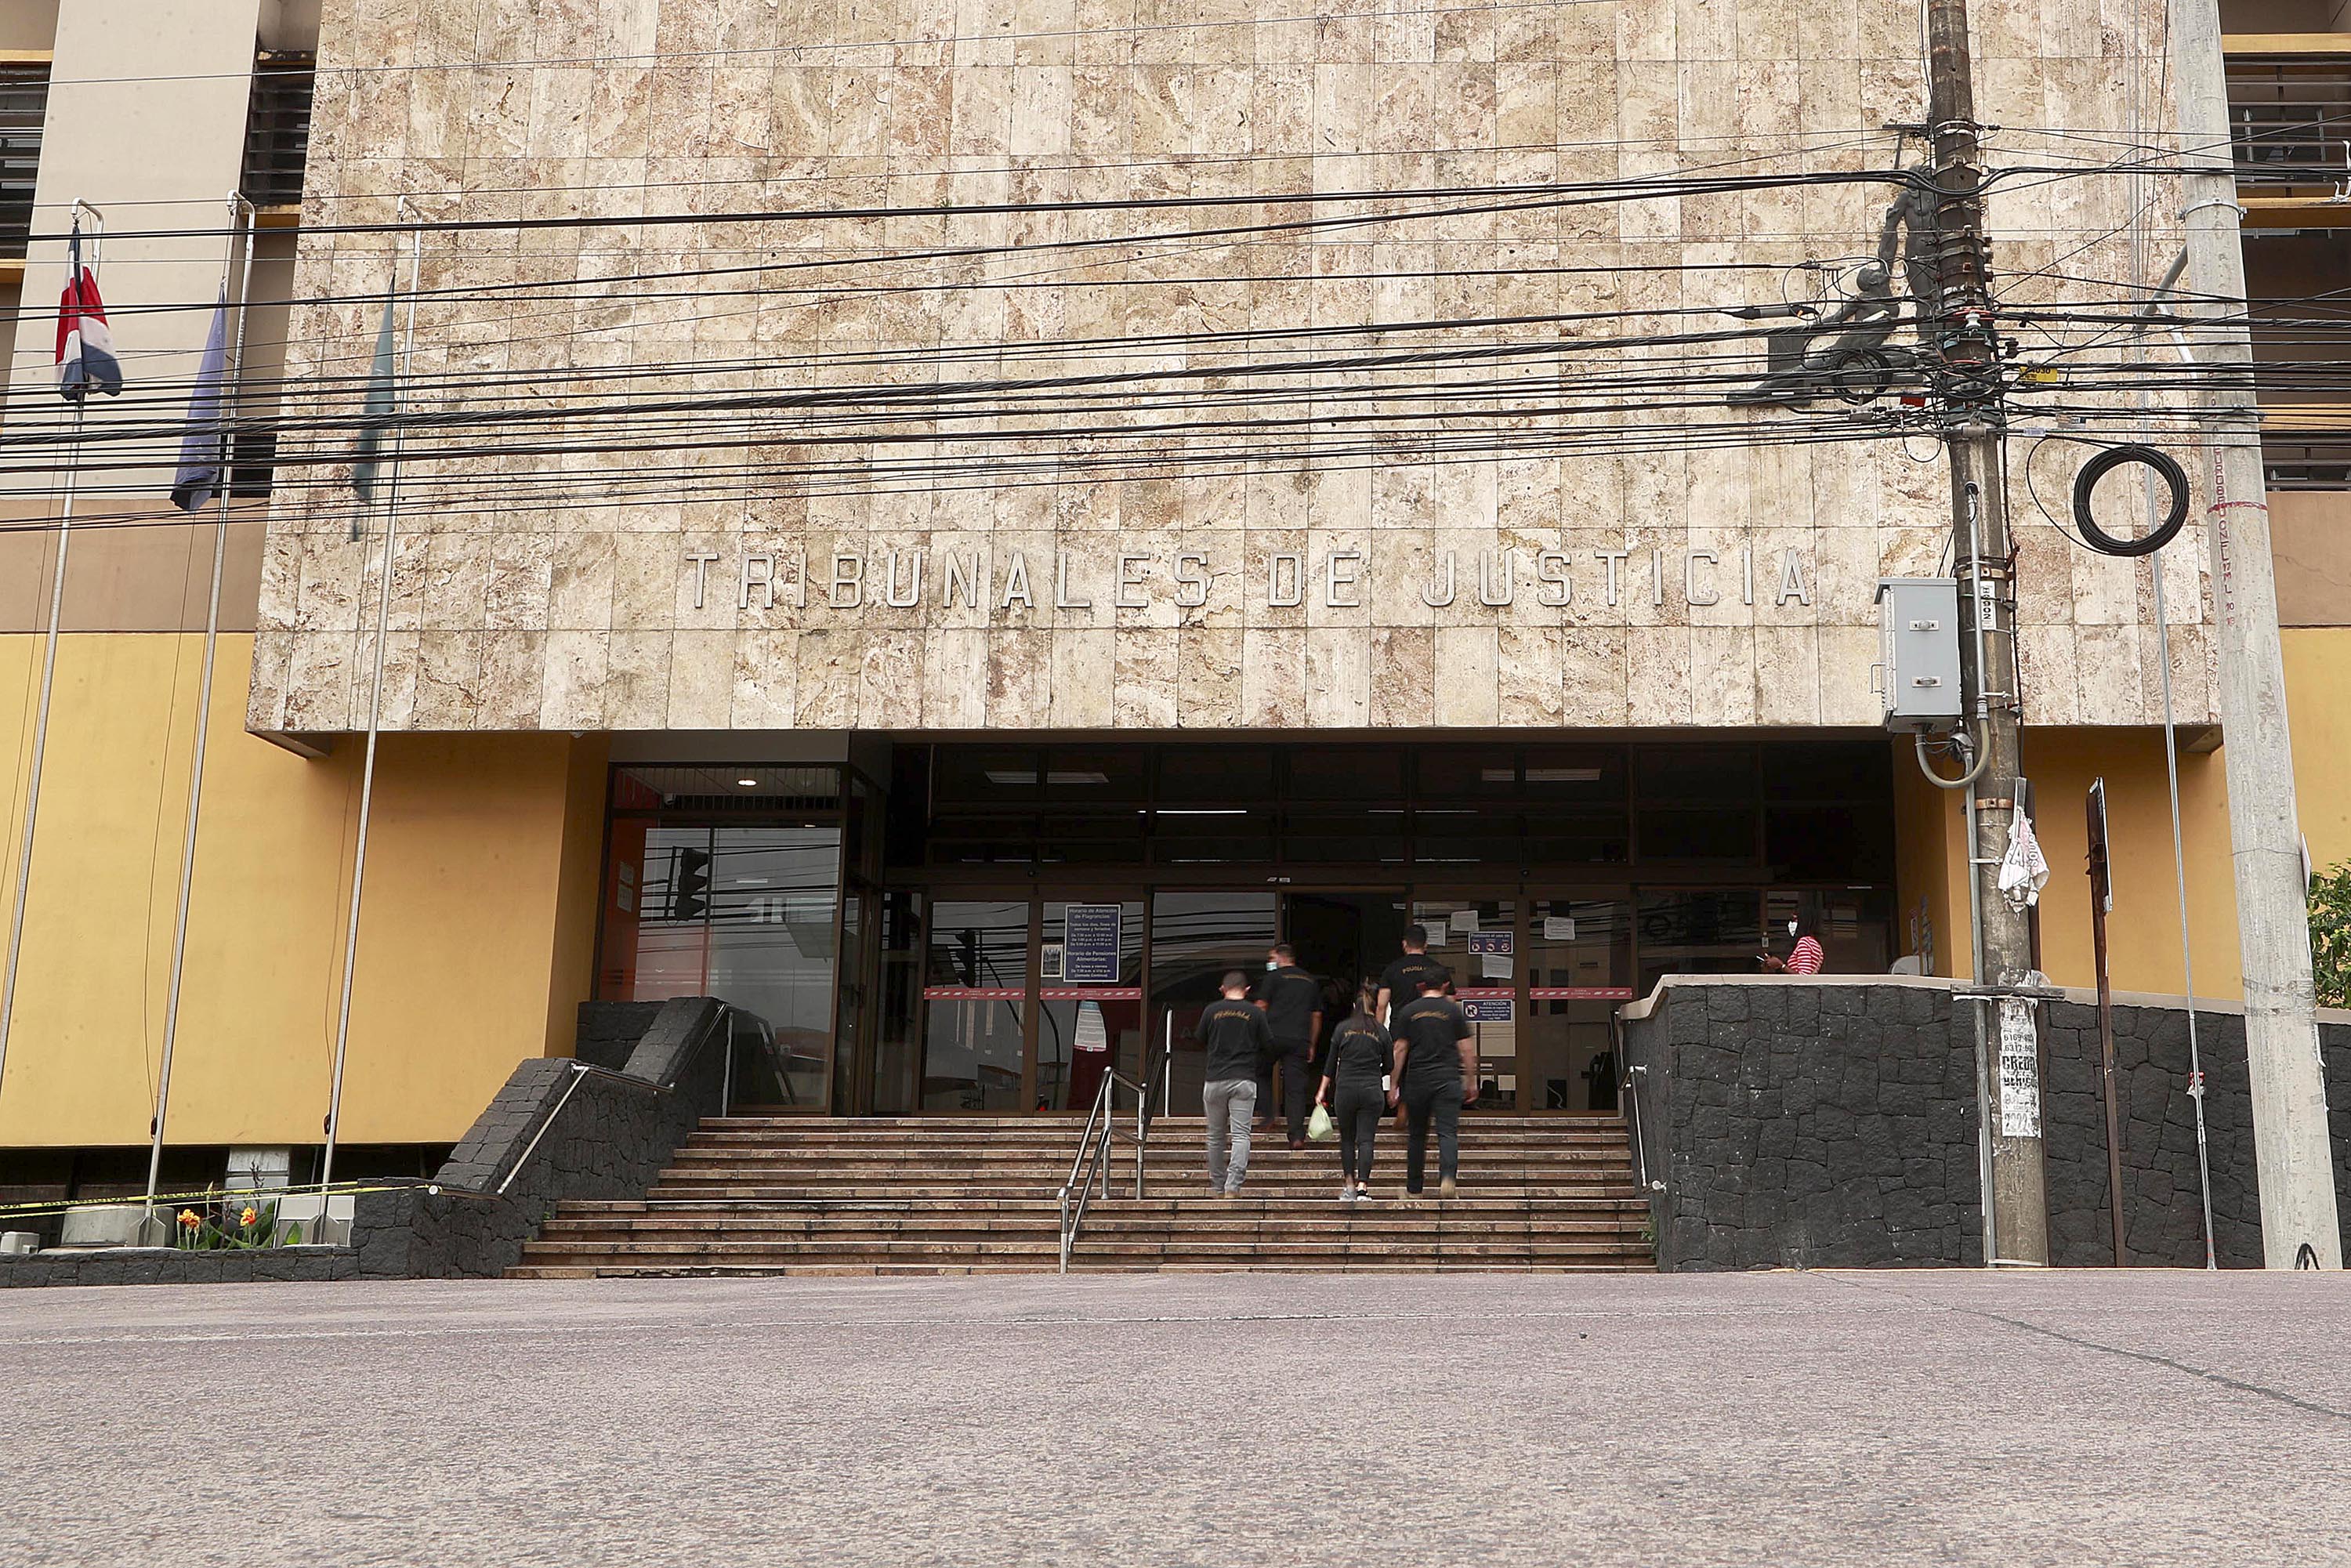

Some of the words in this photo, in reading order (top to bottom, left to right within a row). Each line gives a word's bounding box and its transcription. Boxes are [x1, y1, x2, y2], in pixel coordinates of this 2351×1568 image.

[686, 551, 1208, 610] TRIBUNALES
[1268, 550, 1360, 607] DE
[1422, 549, 1811, 607] JUSTICIA
